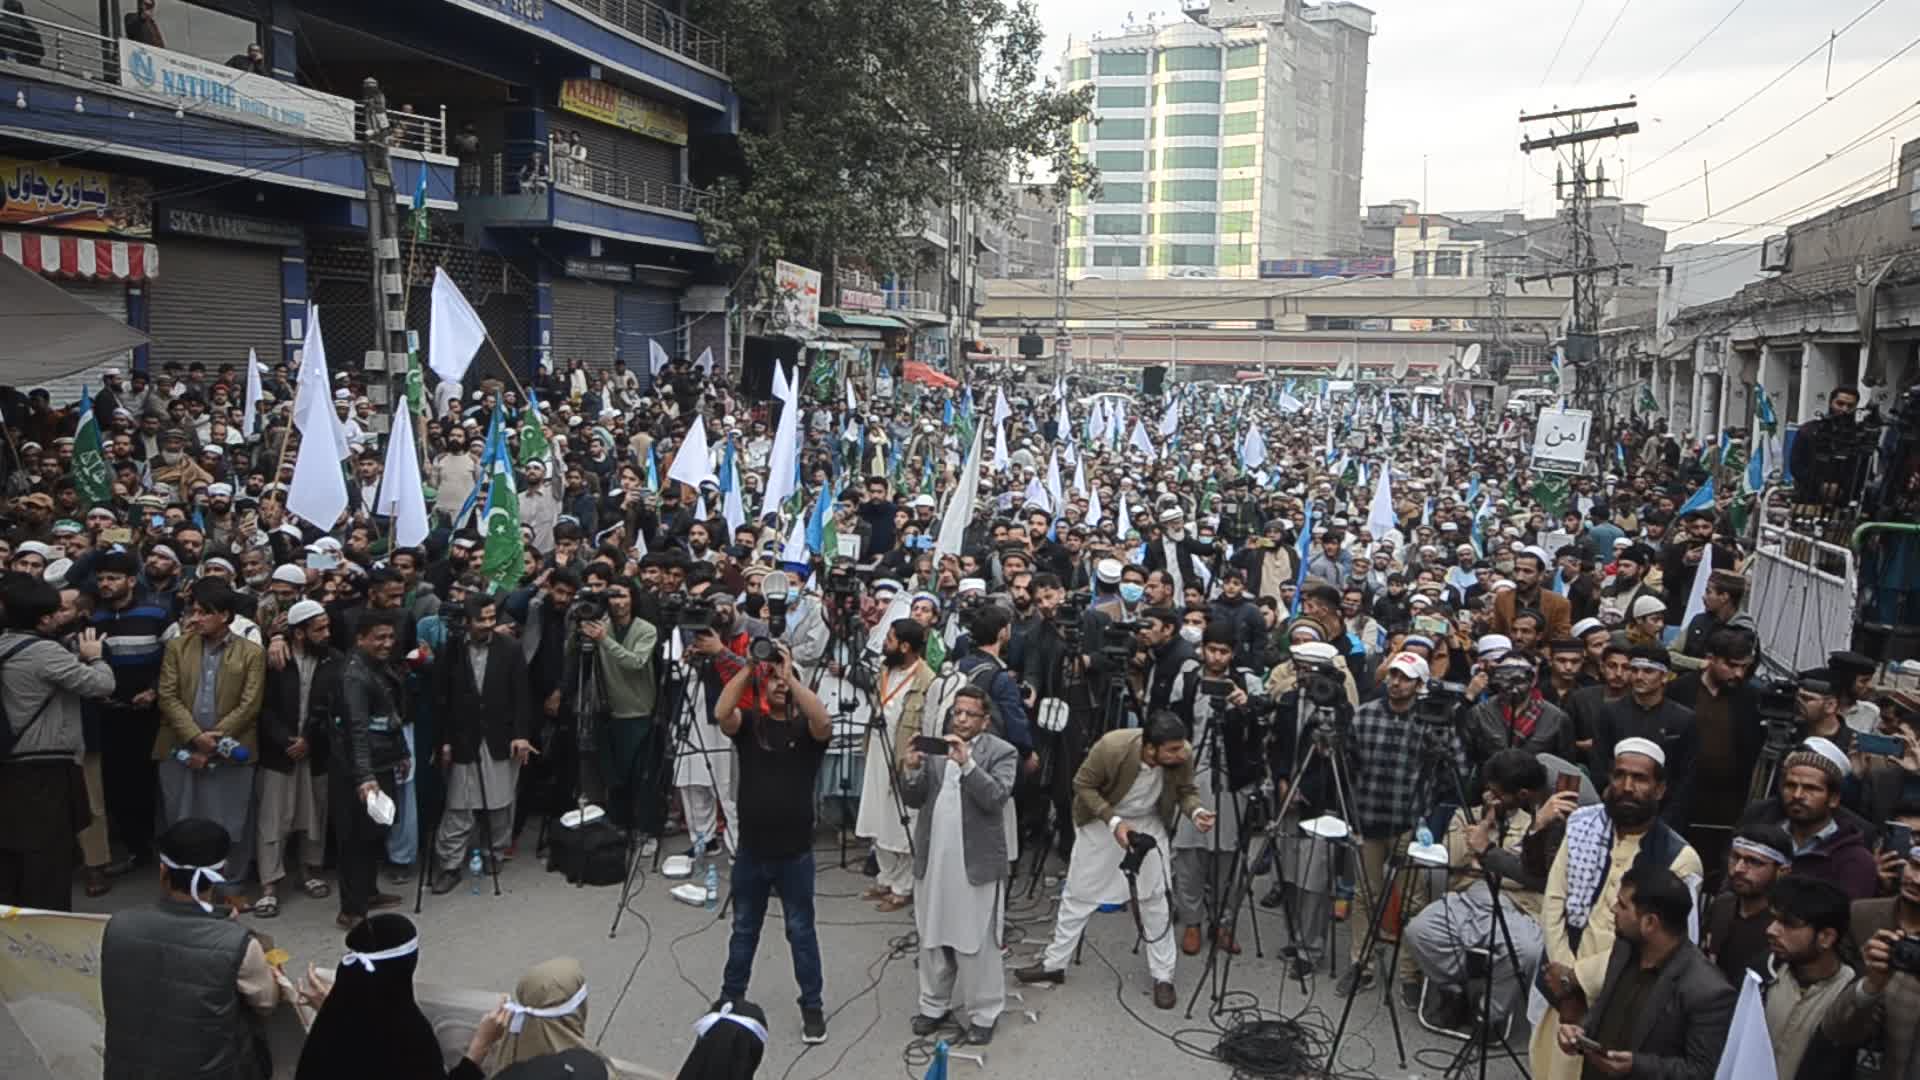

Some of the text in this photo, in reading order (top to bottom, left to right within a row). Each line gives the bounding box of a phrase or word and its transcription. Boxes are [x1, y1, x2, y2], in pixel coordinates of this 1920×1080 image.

[162, 70, 235, 107] NATURE
[169, 208, 206, 233] SKY
[1545, 420, 1586, 446] امن
